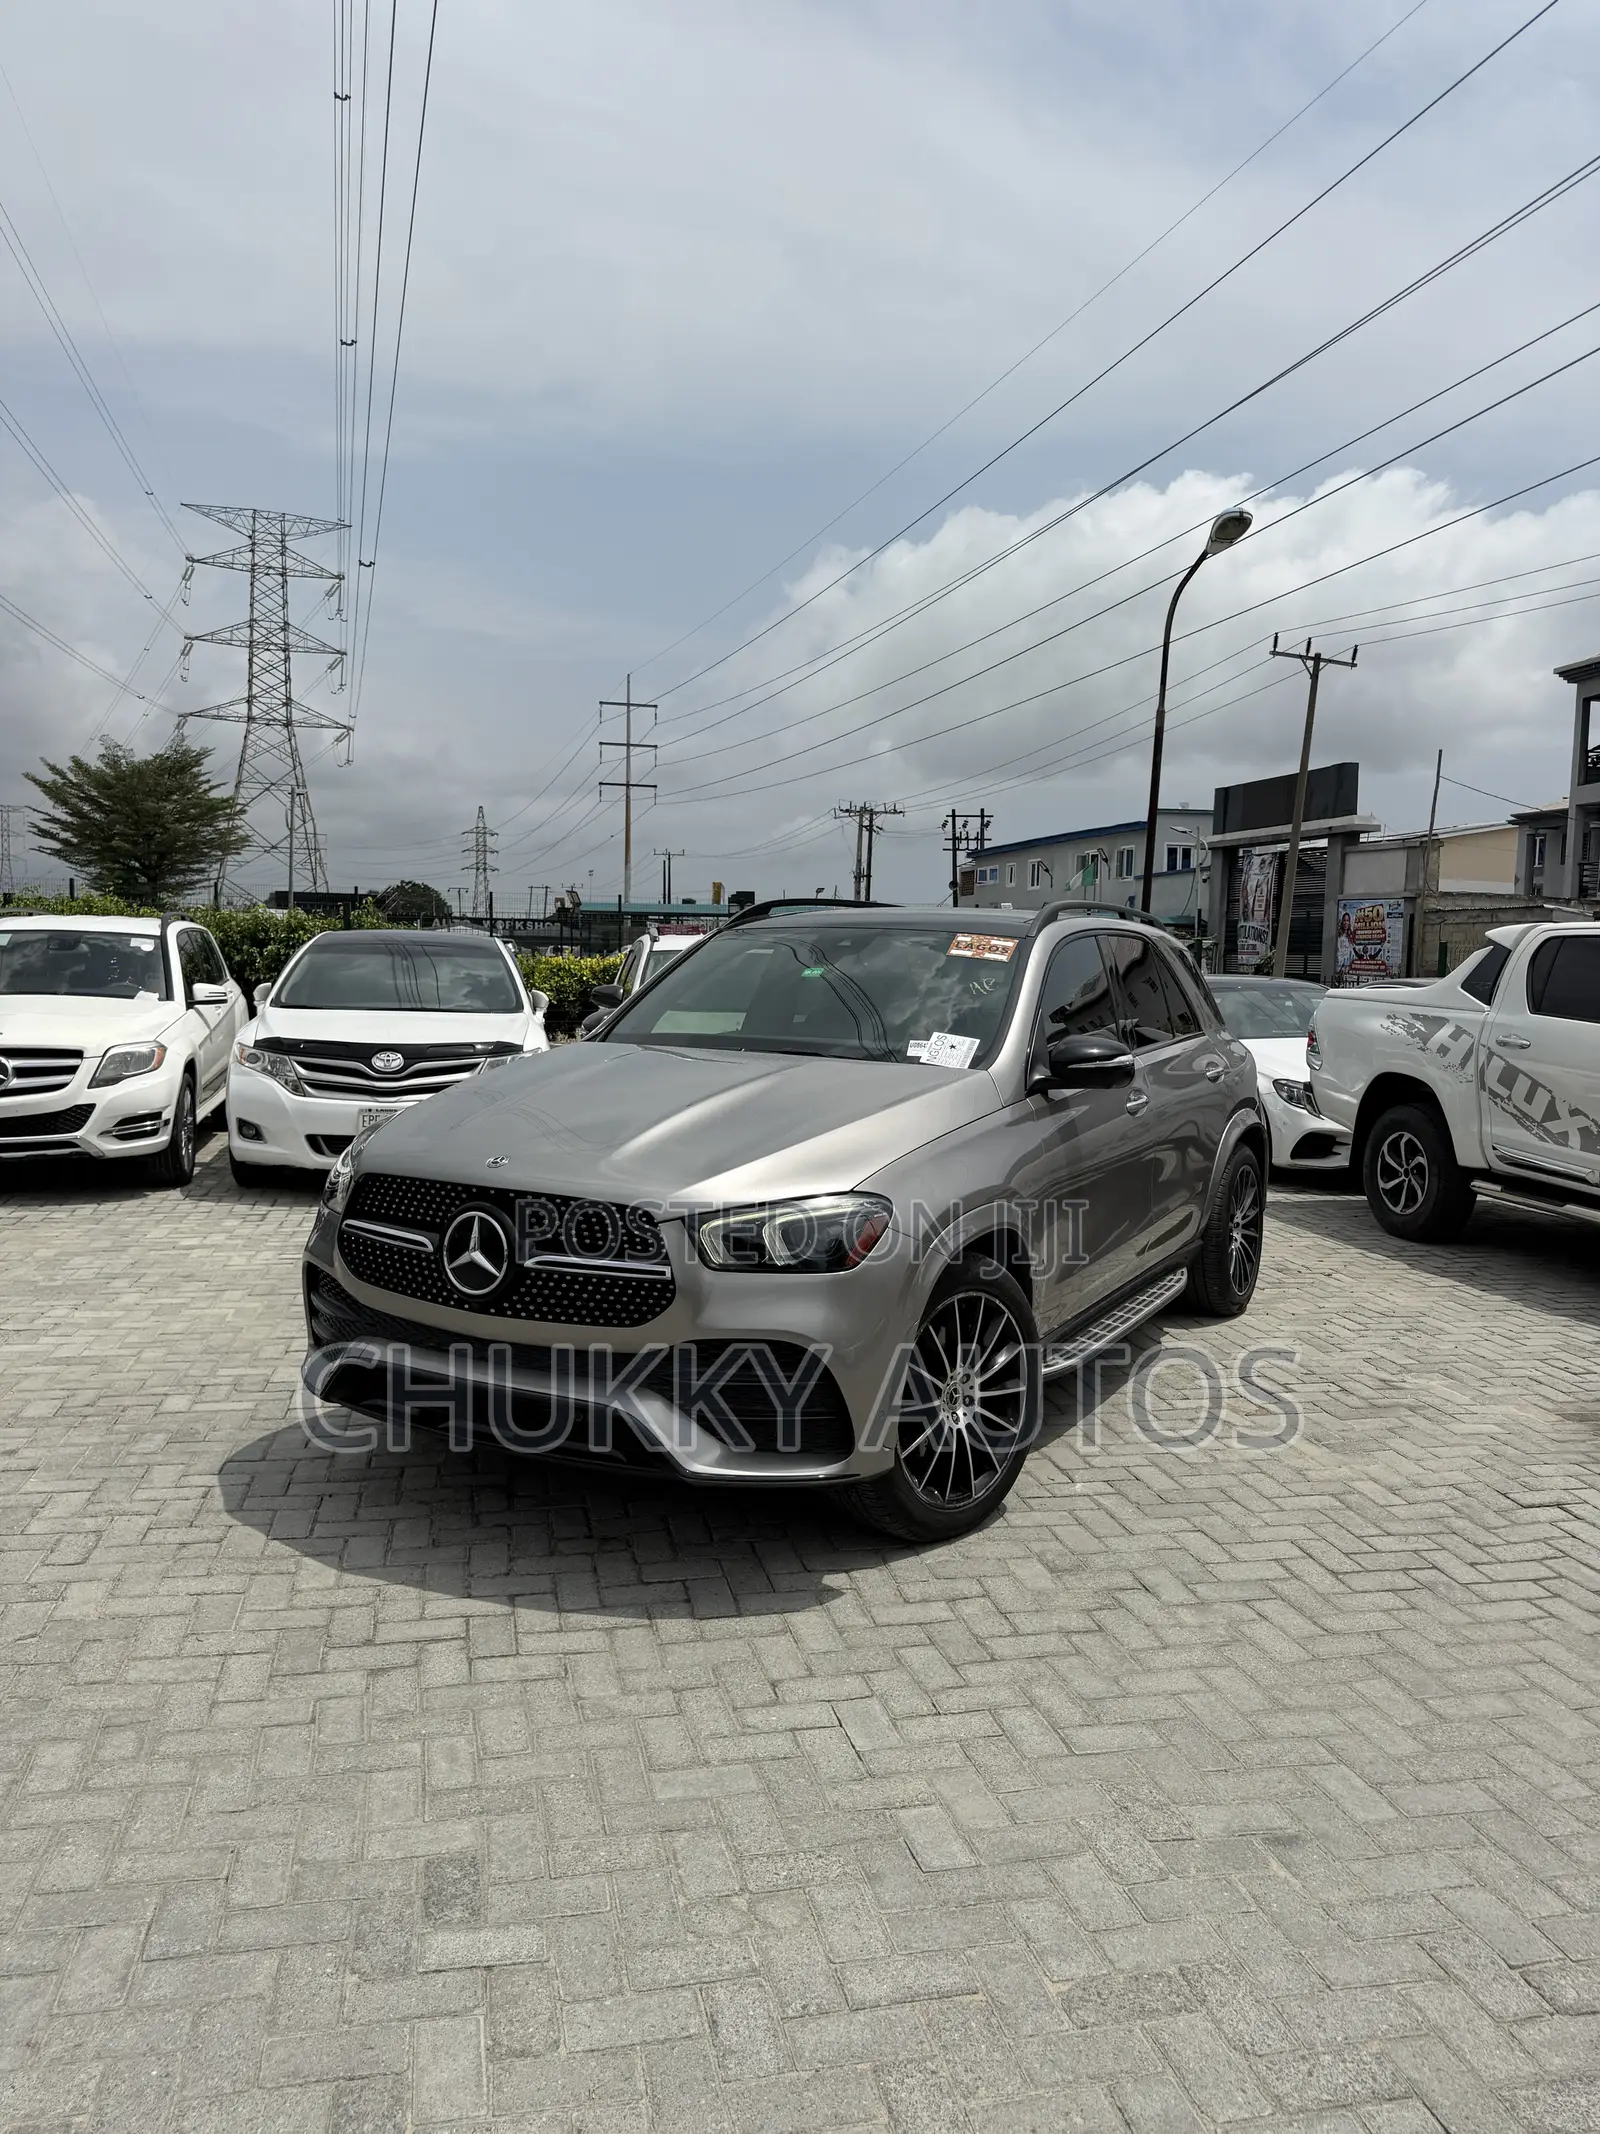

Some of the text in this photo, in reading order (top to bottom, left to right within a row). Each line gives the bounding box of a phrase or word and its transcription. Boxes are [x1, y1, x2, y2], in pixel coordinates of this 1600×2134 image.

[1355, 921, 1385, 930] MILLION
[955, 941, 1010, 954] LAGOS
[1425, 1018, 1594, 1151] HILUX
